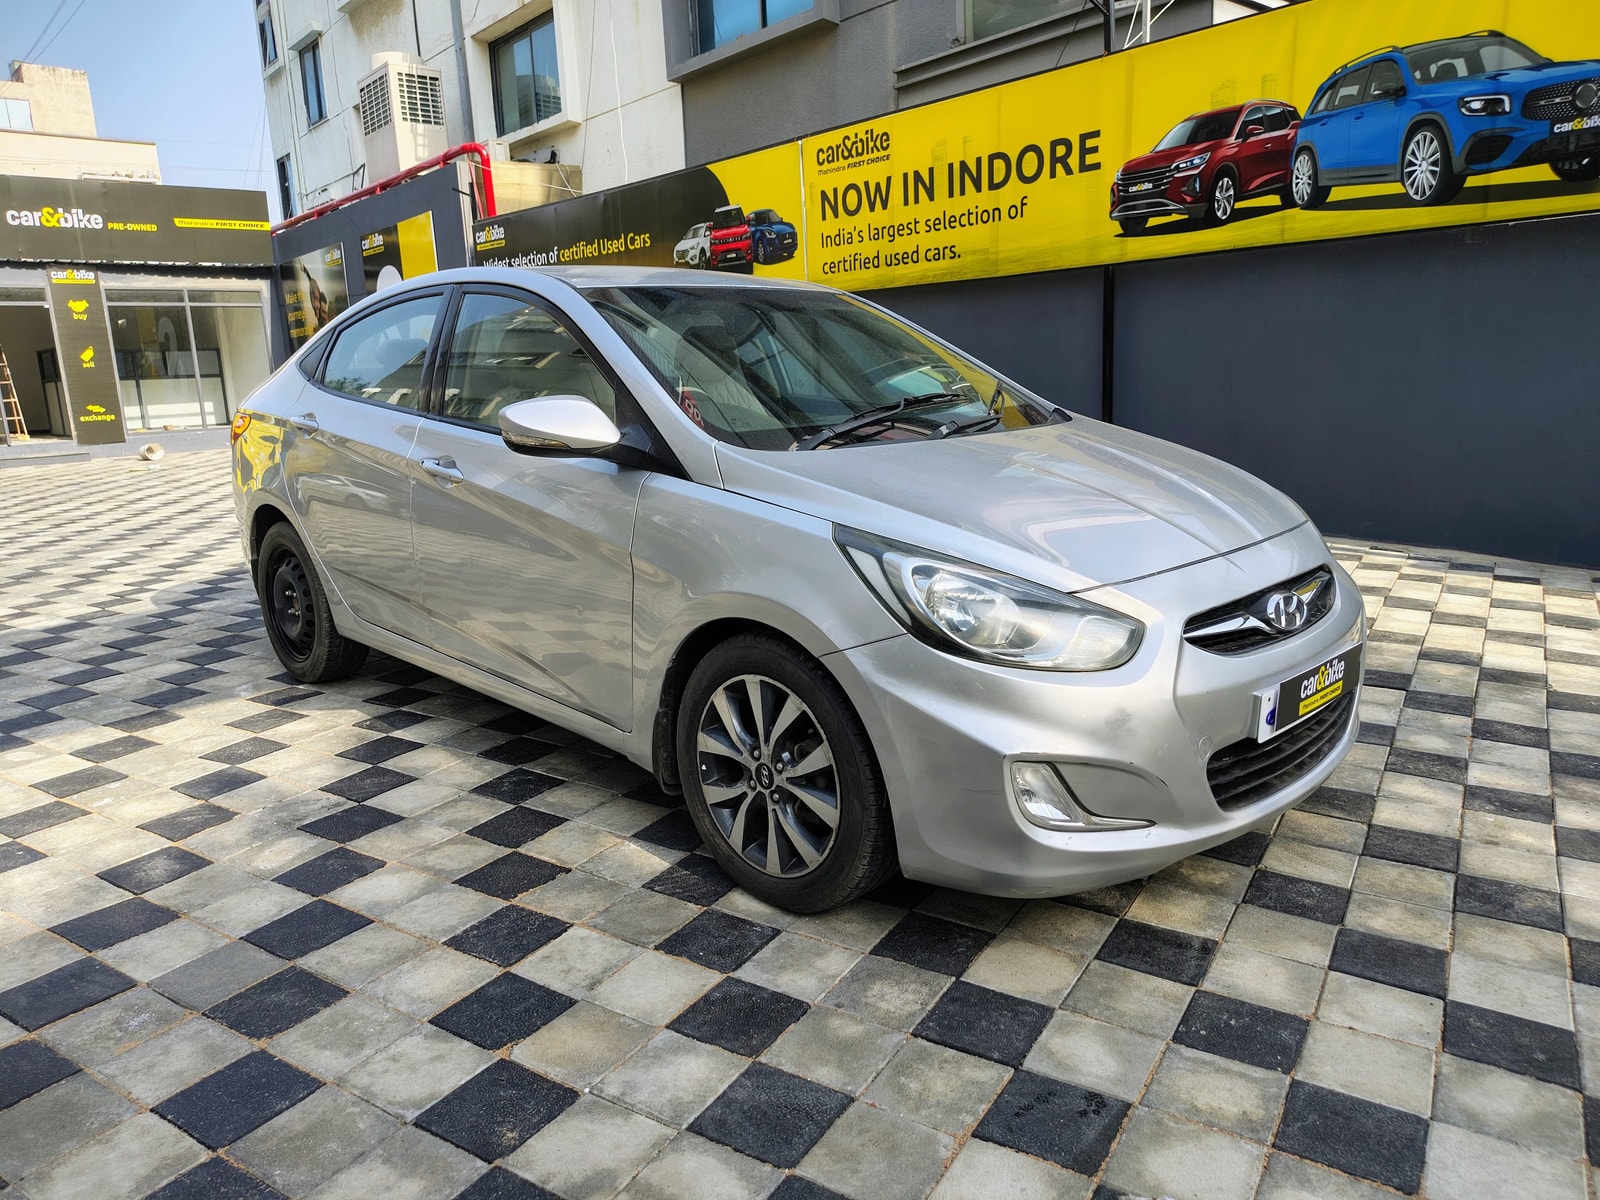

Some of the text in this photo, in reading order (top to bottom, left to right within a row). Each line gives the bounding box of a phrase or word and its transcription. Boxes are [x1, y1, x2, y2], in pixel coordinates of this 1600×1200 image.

[816, 128, 891, 167] car&bike
[820, 129, 1101, 222] NOW IN INDORE
[847, 160, 866, 170] FIRST
[866, 154, 891, 165] CHOICE
[6, 206, 158, 232] car&bike PRE-OWNED
[868, 217, 920, 243] largest
[924, 205, 1002, 233] selection
[1007, 195, 1028, 220] of
[475, 224, 505, 244] car&bike
[511, 250, 547, 268] selection
[548, 245, 559, 264] of
[560, 239, 599, 262] certified
[600, 233, 625, 255] Used
[627, 232, 651, 250] Cars
[822, 244, 961, 275] certified used cars.
[50, 268, 95, 280] car&bike
[73, 312, 88, 321] buy
[79, 414, 116, 422] exchange
[1301, 659, 1344, 698] car&bike
